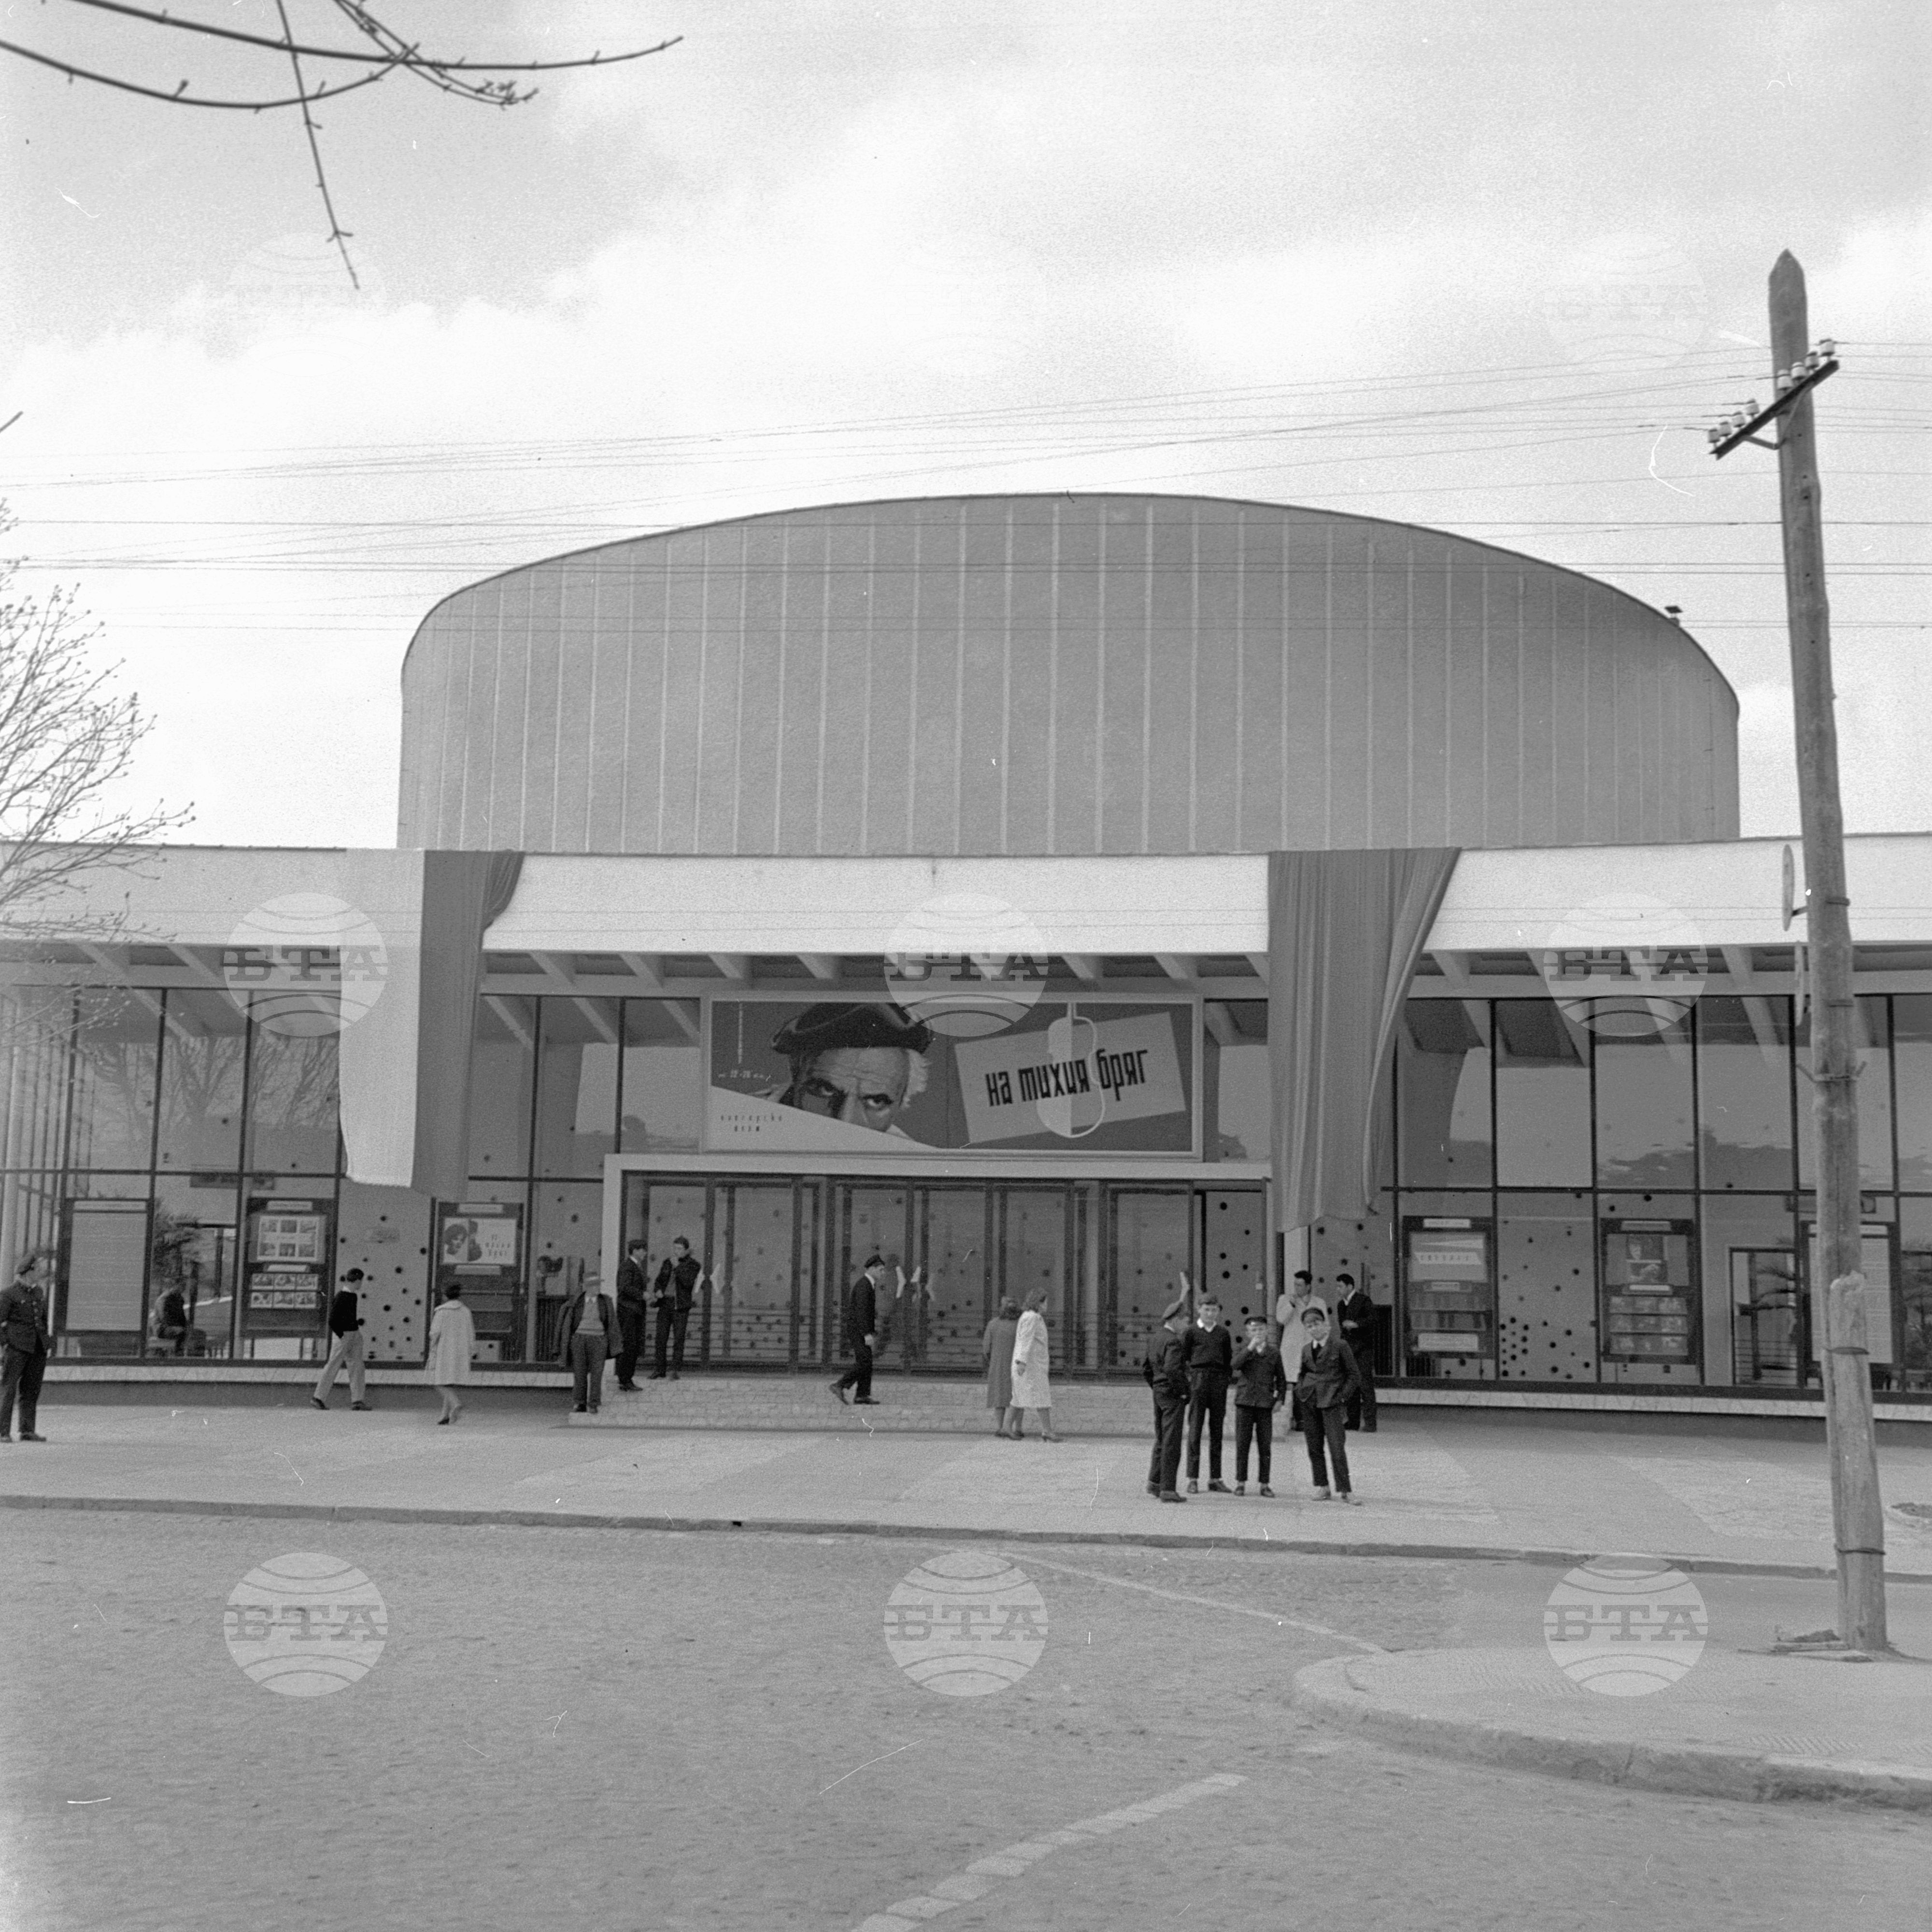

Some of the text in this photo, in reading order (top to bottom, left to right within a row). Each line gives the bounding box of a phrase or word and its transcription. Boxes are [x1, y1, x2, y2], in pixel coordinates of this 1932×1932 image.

[985, 1048, 1148, 1107] на тихия бряг
